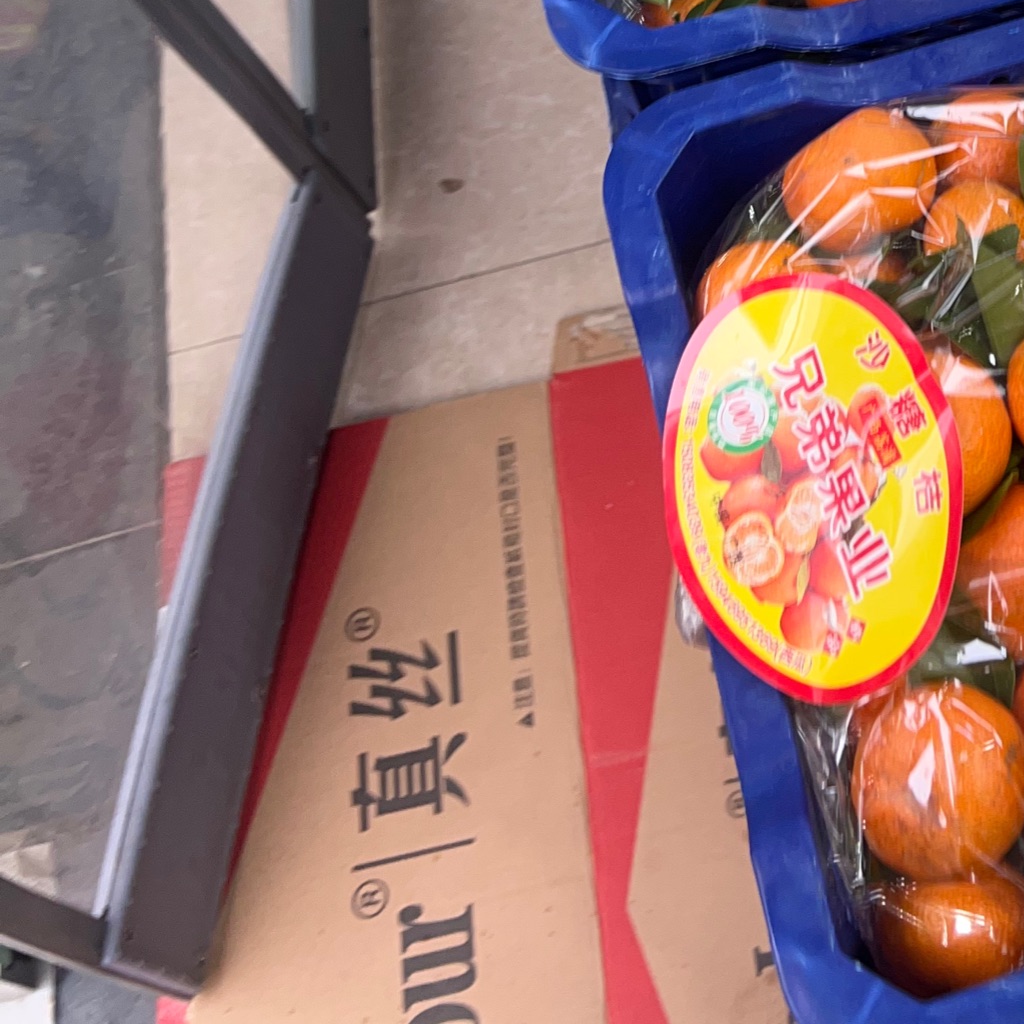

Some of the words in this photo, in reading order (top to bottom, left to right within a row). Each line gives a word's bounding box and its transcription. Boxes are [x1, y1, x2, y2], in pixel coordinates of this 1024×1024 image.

[772, 343, 895, 600] 兄弟果业
[854, 328, 946, 516] 沙糖桔
[347, 629, 471, 833] 真丝
